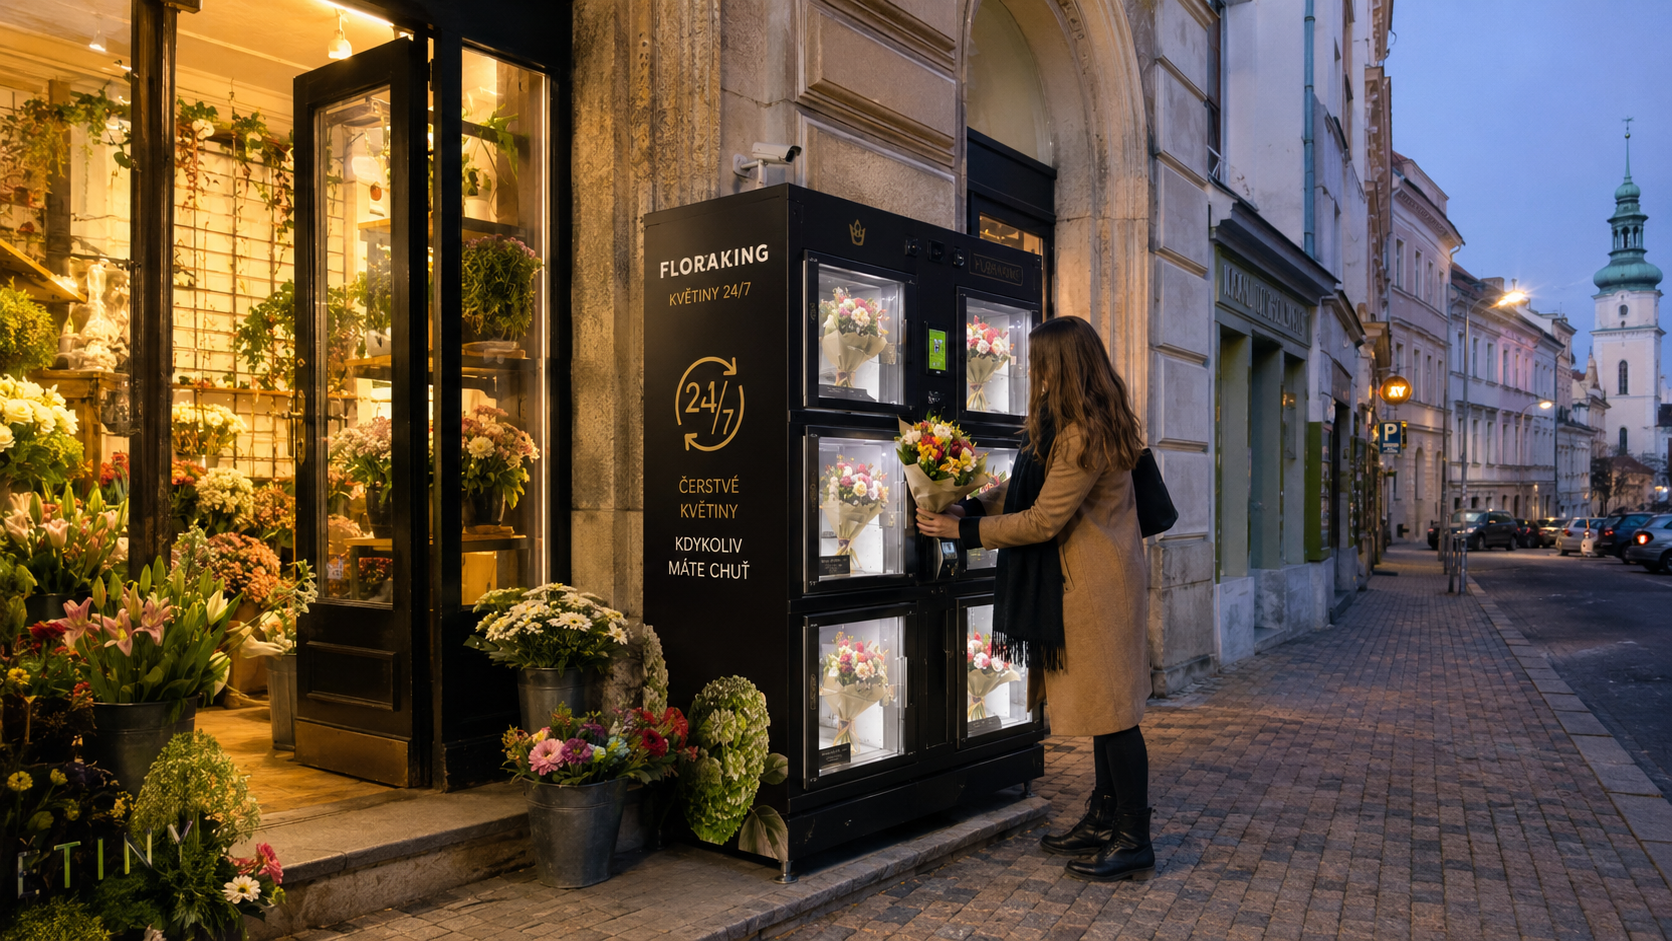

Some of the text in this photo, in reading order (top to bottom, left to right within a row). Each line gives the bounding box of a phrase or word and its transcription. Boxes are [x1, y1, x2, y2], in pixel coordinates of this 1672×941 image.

[660, 243, 769, 279] FLORAKING
[669, 281, 751, 306] KVĚTINY 24/7
[685, 380, 734, 435] 24/7
[1384, 423, 1397, 442] P
[678, 475, 739, 494] ČERSTVÉ
[681, 500, 739, 519] KVĚTINY
[675, 536, 743, 554] KDYKOLIV
[668, 557, 750, 580] MÁTE CHUŤ
